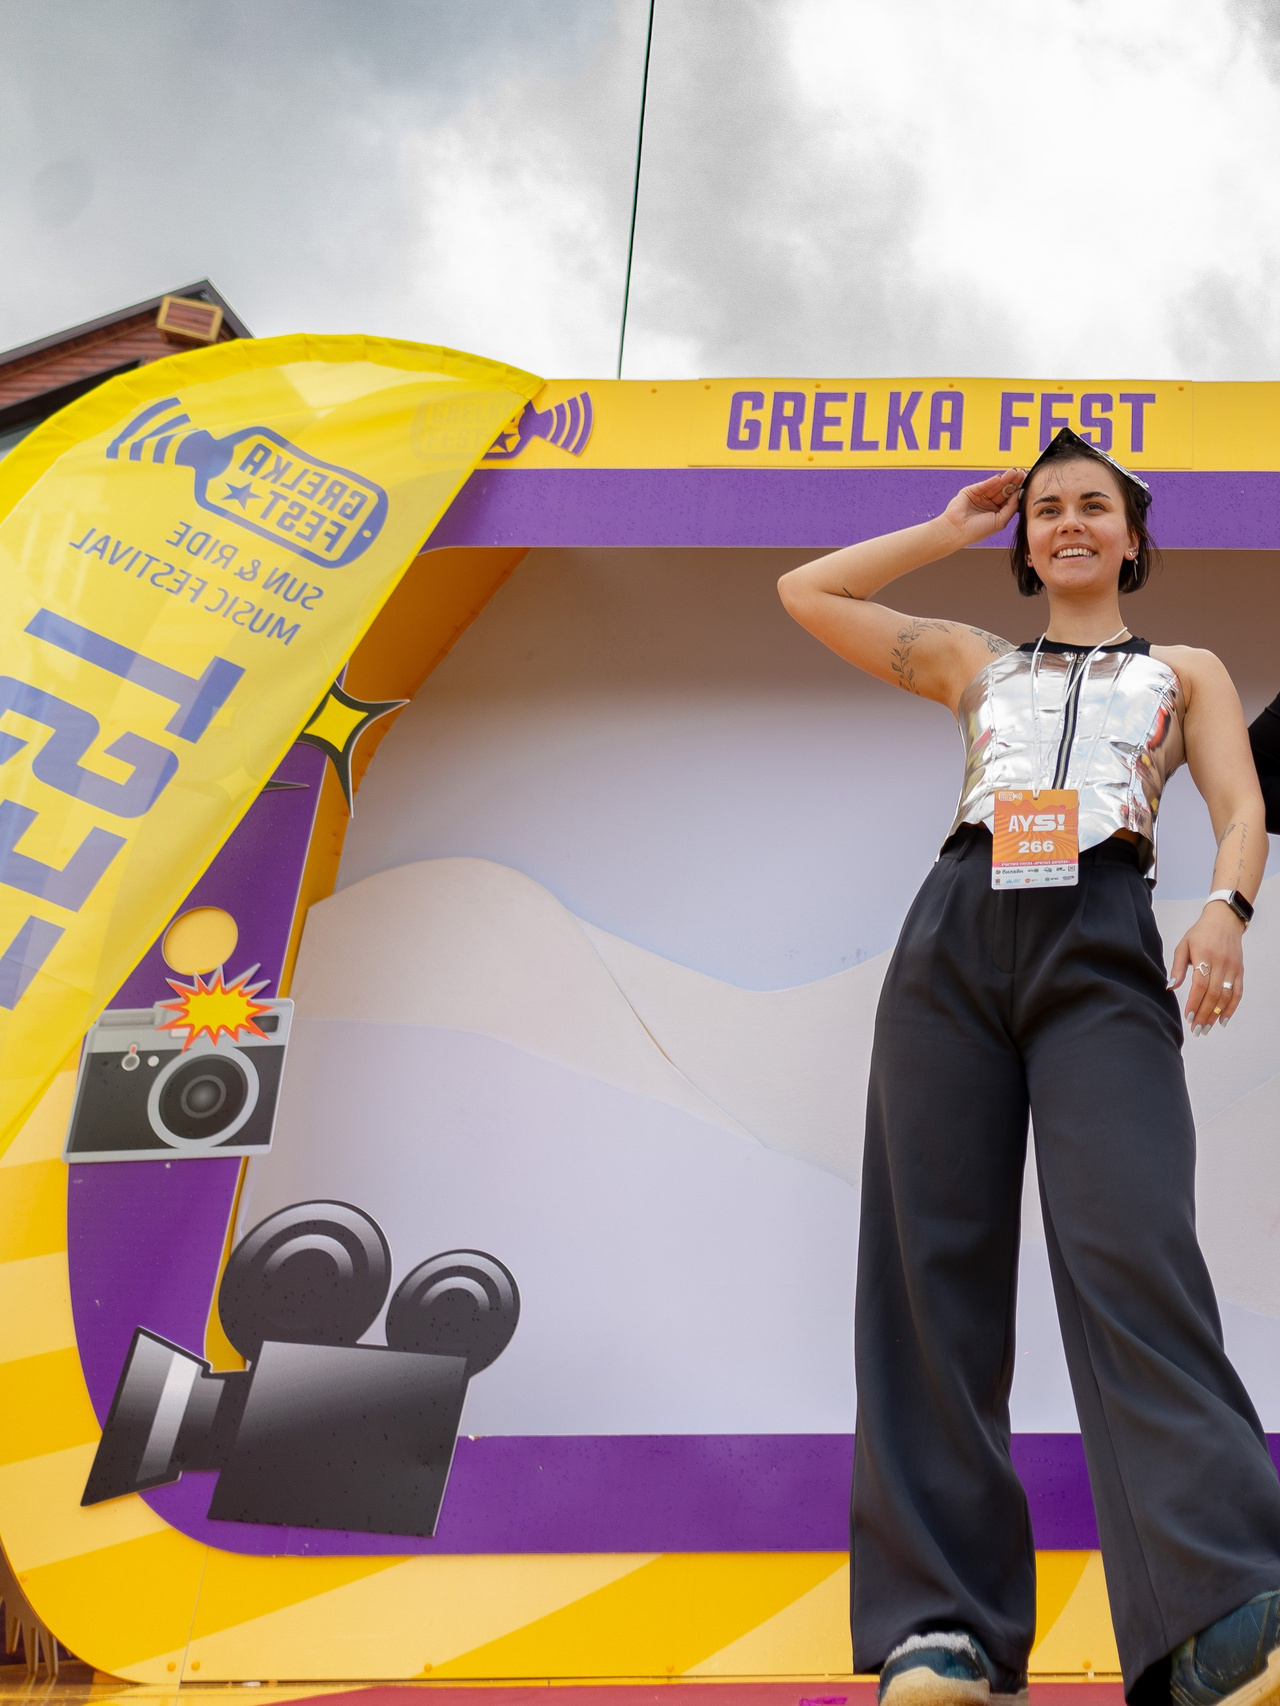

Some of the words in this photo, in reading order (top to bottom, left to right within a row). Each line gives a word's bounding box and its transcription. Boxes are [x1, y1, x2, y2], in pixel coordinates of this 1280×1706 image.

[726, 390, 965, 452] GRELKA
[999, 391, 1157, 453] FEST
[1008, 814, 1066, 833] AYS!
[1017, 840, 1055, 854] 266
